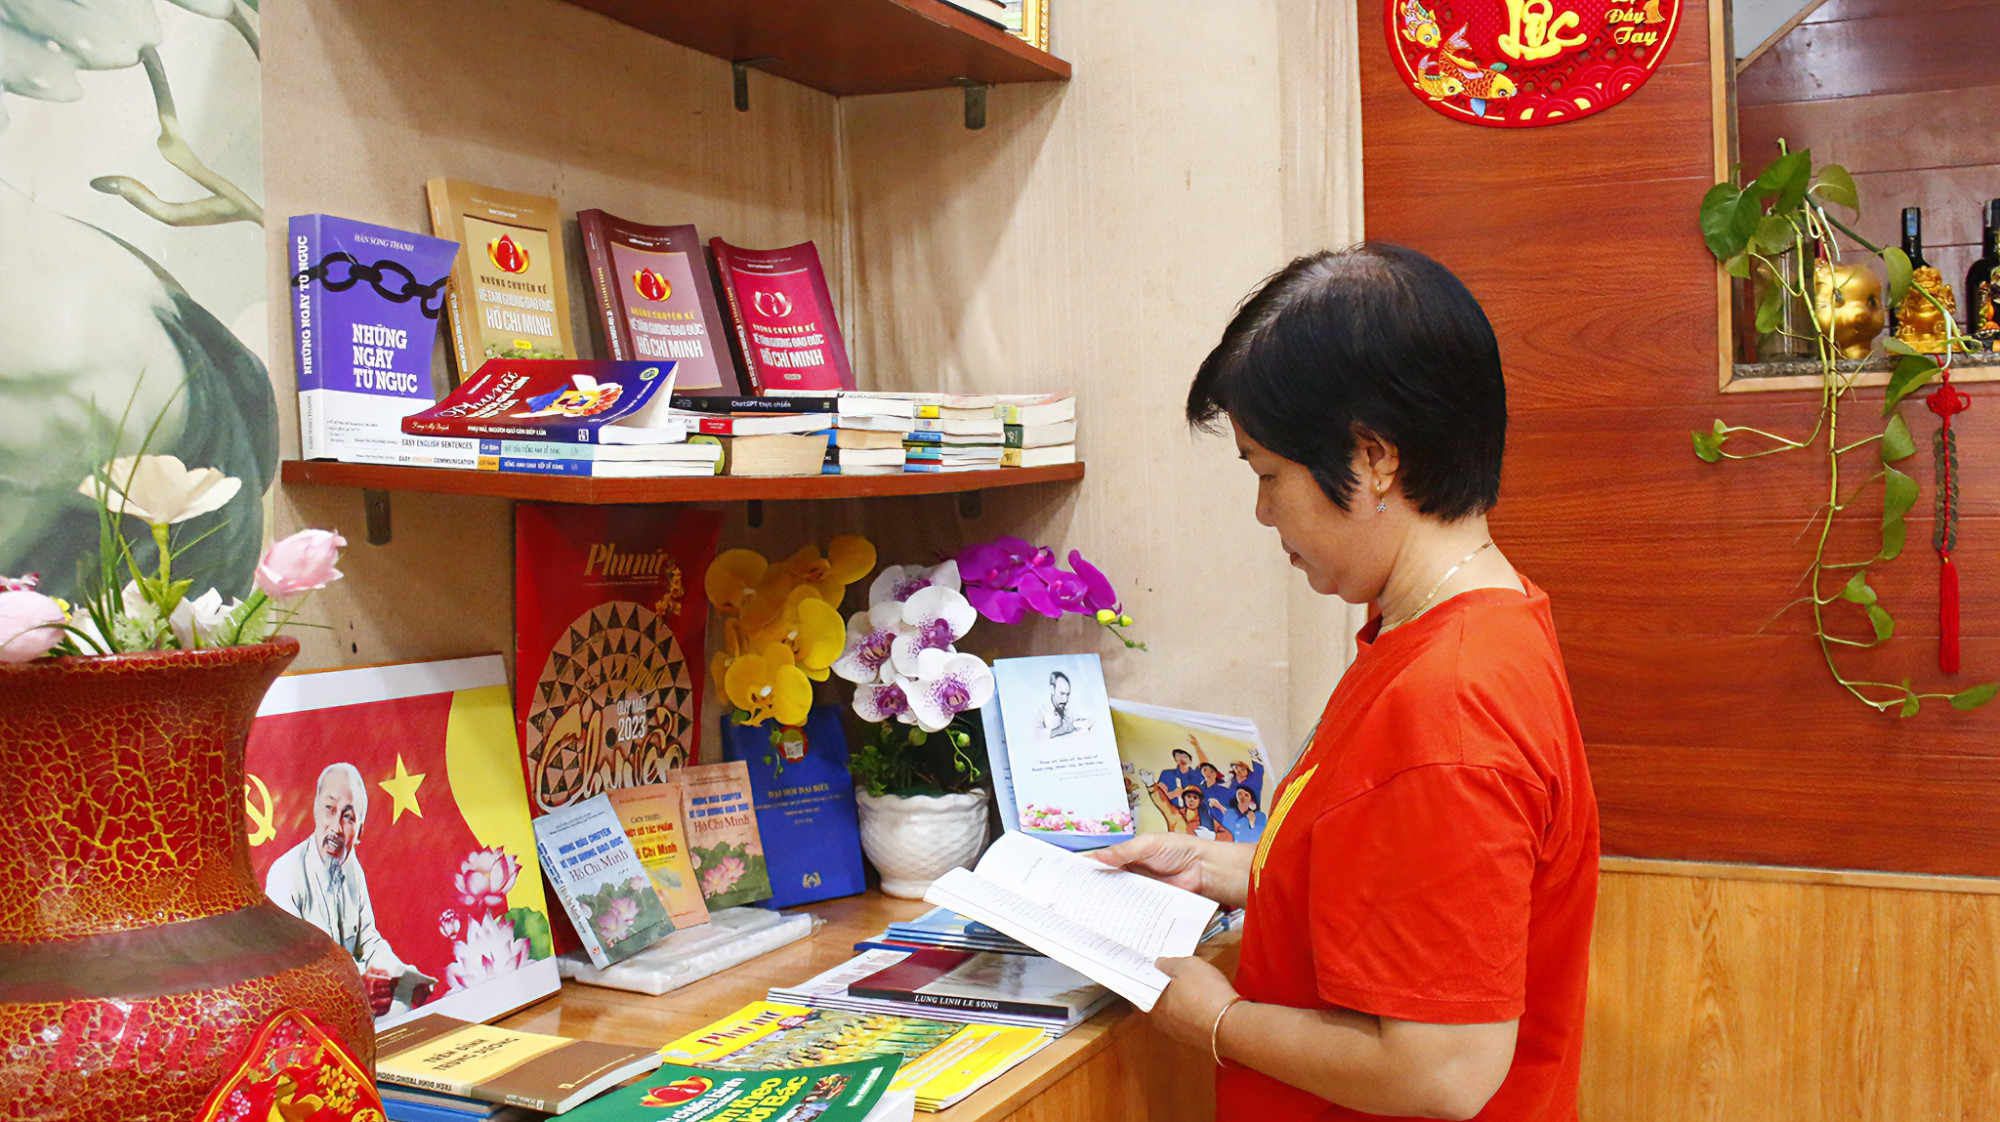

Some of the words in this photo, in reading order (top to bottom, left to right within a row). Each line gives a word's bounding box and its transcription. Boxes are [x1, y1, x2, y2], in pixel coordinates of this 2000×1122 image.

[1613, 26, 1659, 46] Tay
[390, 240, 415, 251] THANH
[522, 313, 553, 337] MINH
[352, 323, 408, 349] NHỮNG
[353, 345, 394, 370] NGÀY
[667, 340, 704, 358] MINH
[788, 348, 825, 368] MINH
[375, 370, 418, 396] NGỤC
[402, 438, 415, 447] EASY
[416, 439, 439, 447] ENGLISH
[441, 440, 473, 450] SENTENCES
[433, 457, 475, 465] COMMUNICATION
[618, 715, 647, 741] 2023
[724, 814, 750, 827] Minh
[600, 849, 629, 869] Minh
[657, 842, 678, 856] Minh
[915, 994, 938, 1004] LUNG
[939, 997, 960, 1006] LINH
[728, 1077, 783, 1108] theo
[759, 1074, 810, 1107] Bác
